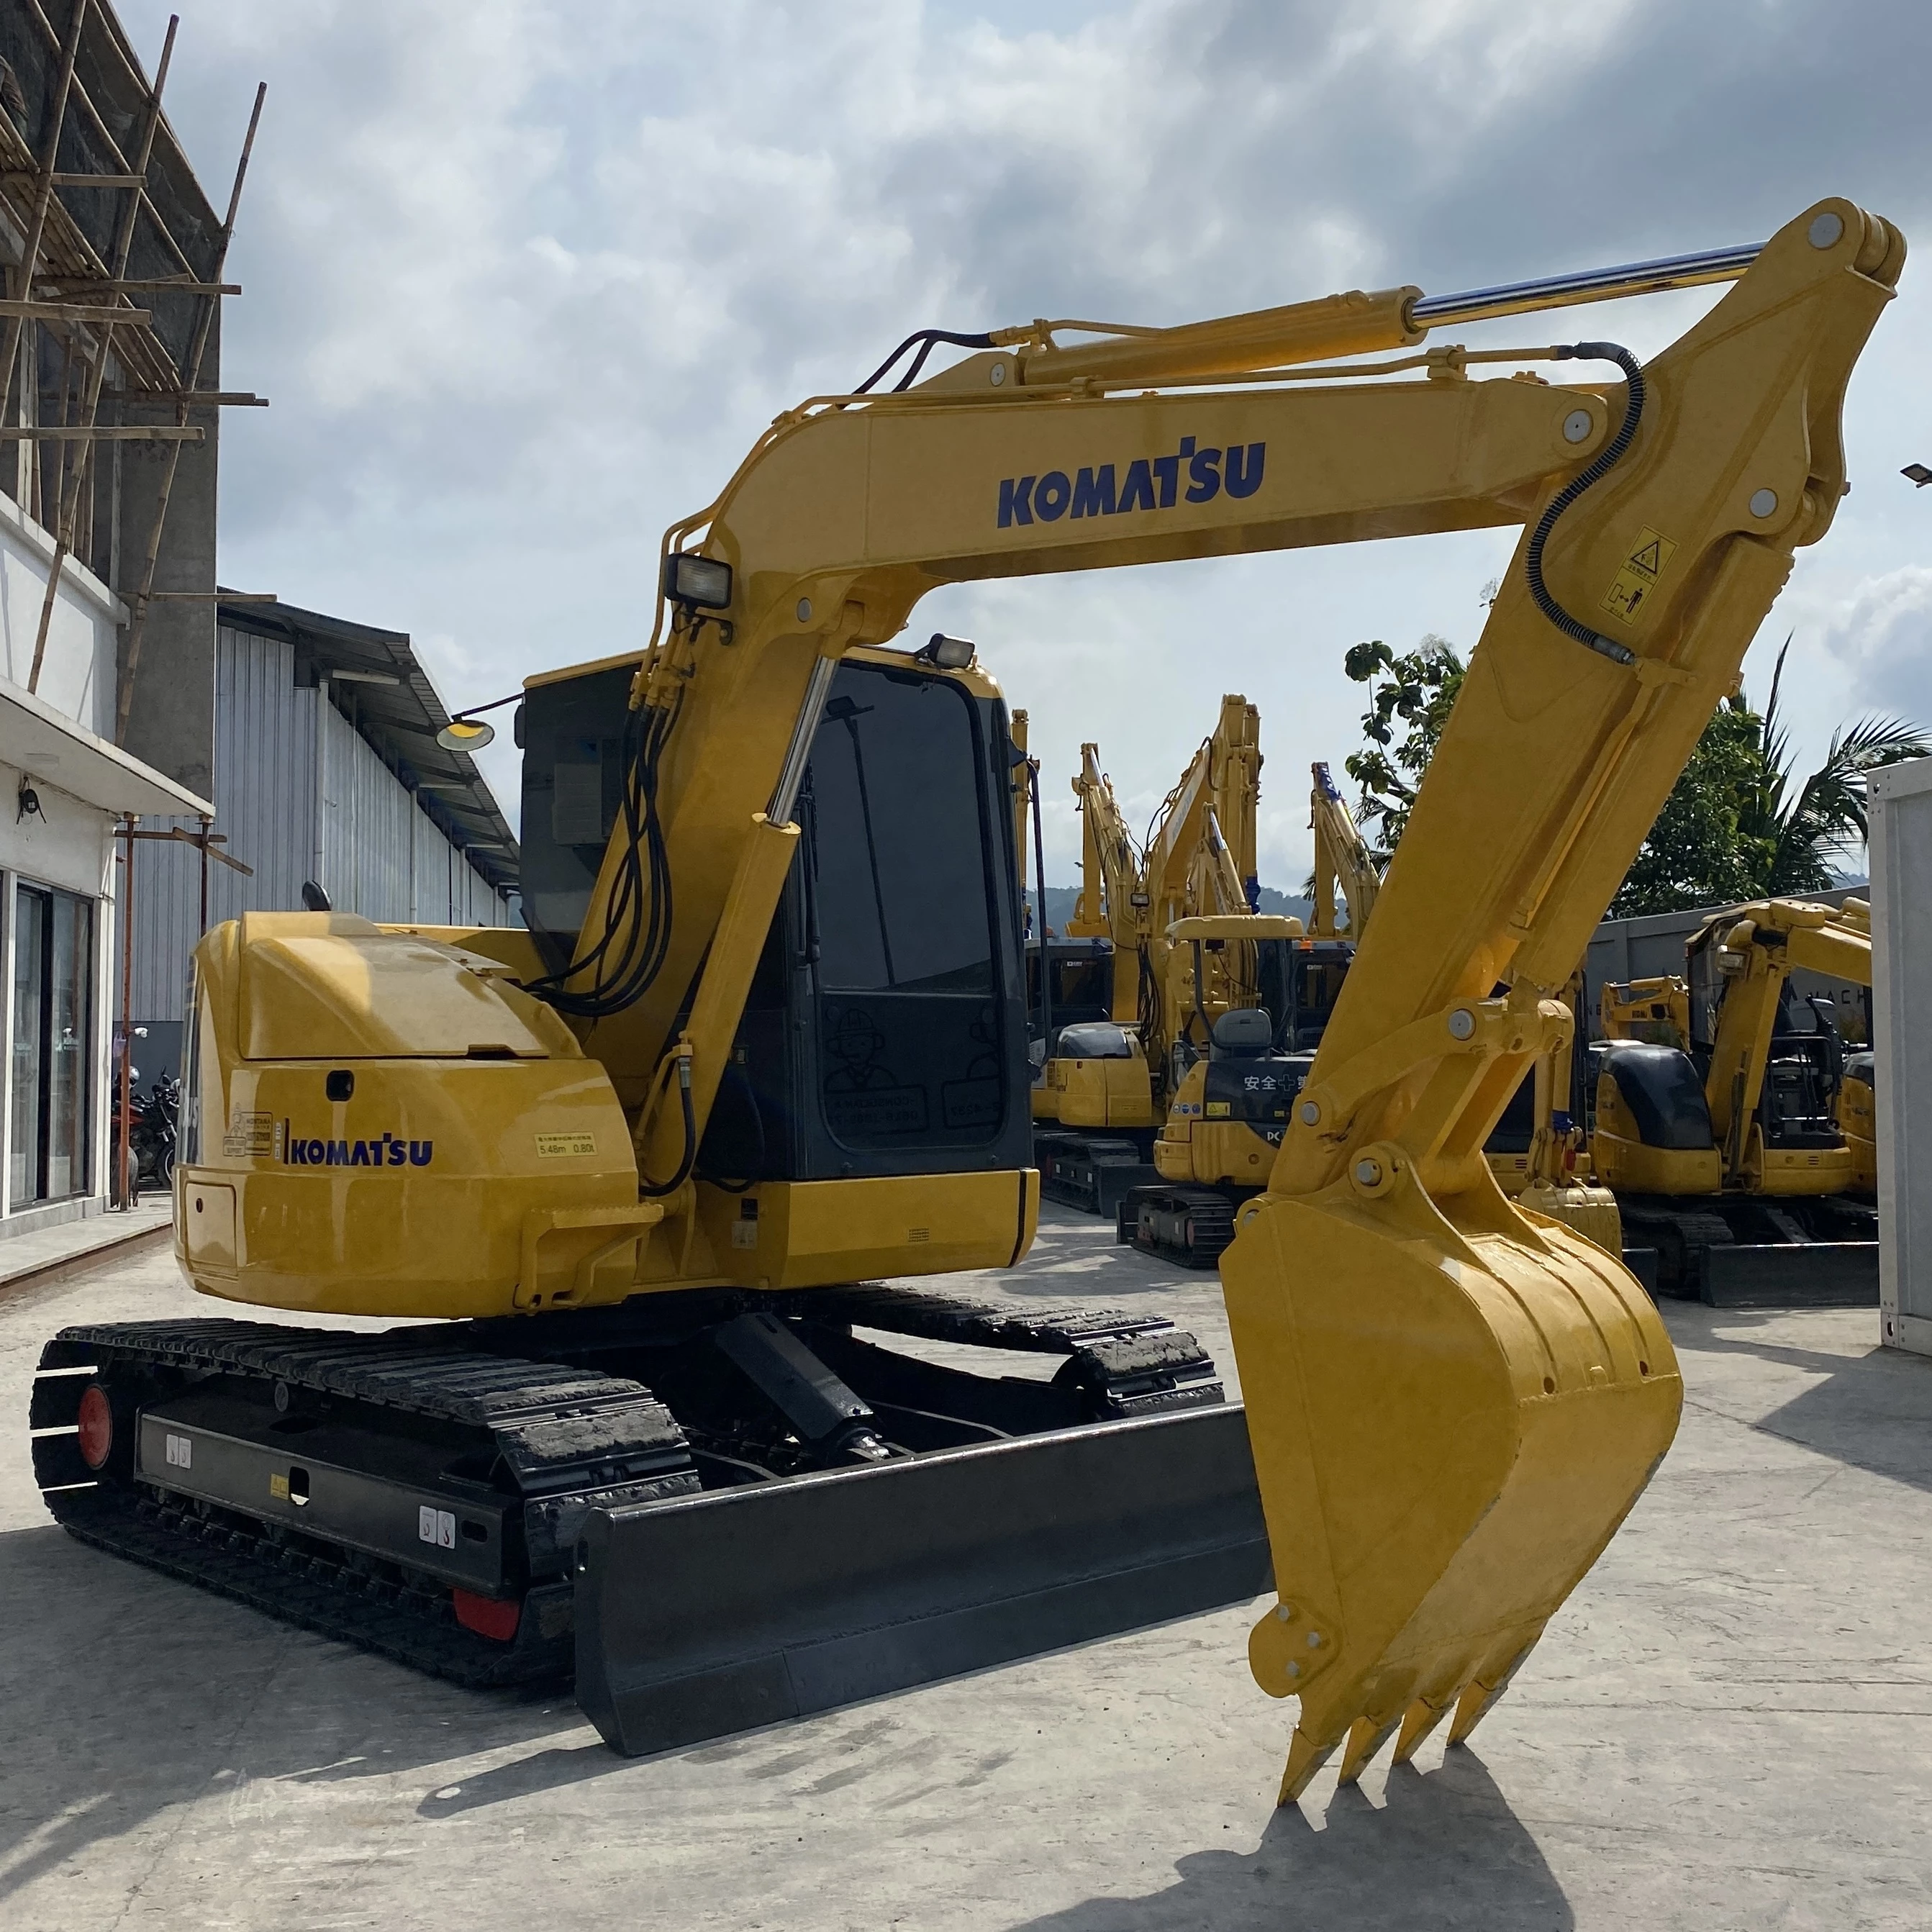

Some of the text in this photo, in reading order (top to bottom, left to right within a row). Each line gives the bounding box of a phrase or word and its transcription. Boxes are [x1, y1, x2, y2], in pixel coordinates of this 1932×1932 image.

[997, 436, 1266, 528] KOMATSU
[1245, 1076, 1276, 1090] 安全
[291, 1133, 433, 1166] KOMATSU
